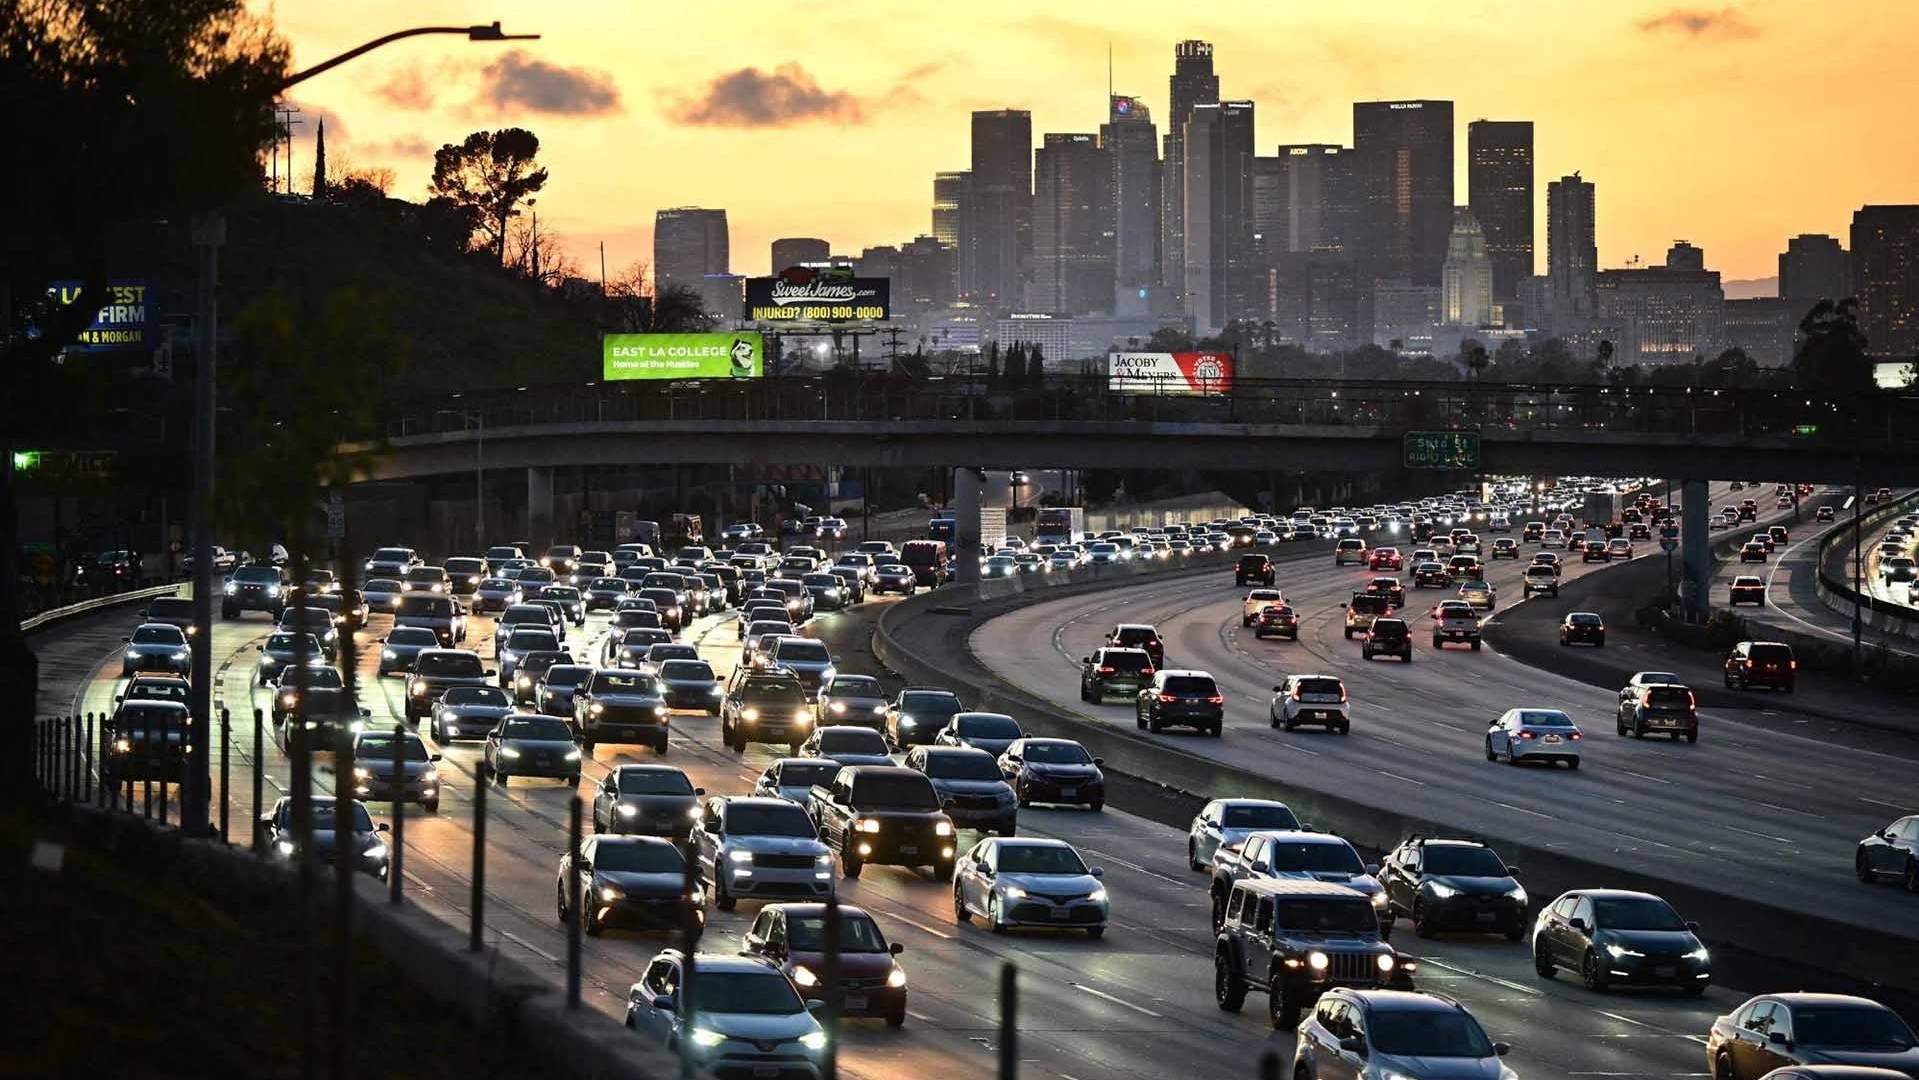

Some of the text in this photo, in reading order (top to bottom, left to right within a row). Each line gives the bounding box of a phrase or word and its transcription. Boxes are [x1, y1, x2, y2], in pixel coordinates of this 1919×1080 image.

[98, 305, 145, 324] FIRM
[753, 306, 883, 319] INJURED? (800) 900-0000
[92, 331, 100, 343] &
[101, 330, 142, 343] MORGAN
[613, 347, 727, 356] EAST LA COLLEGE
